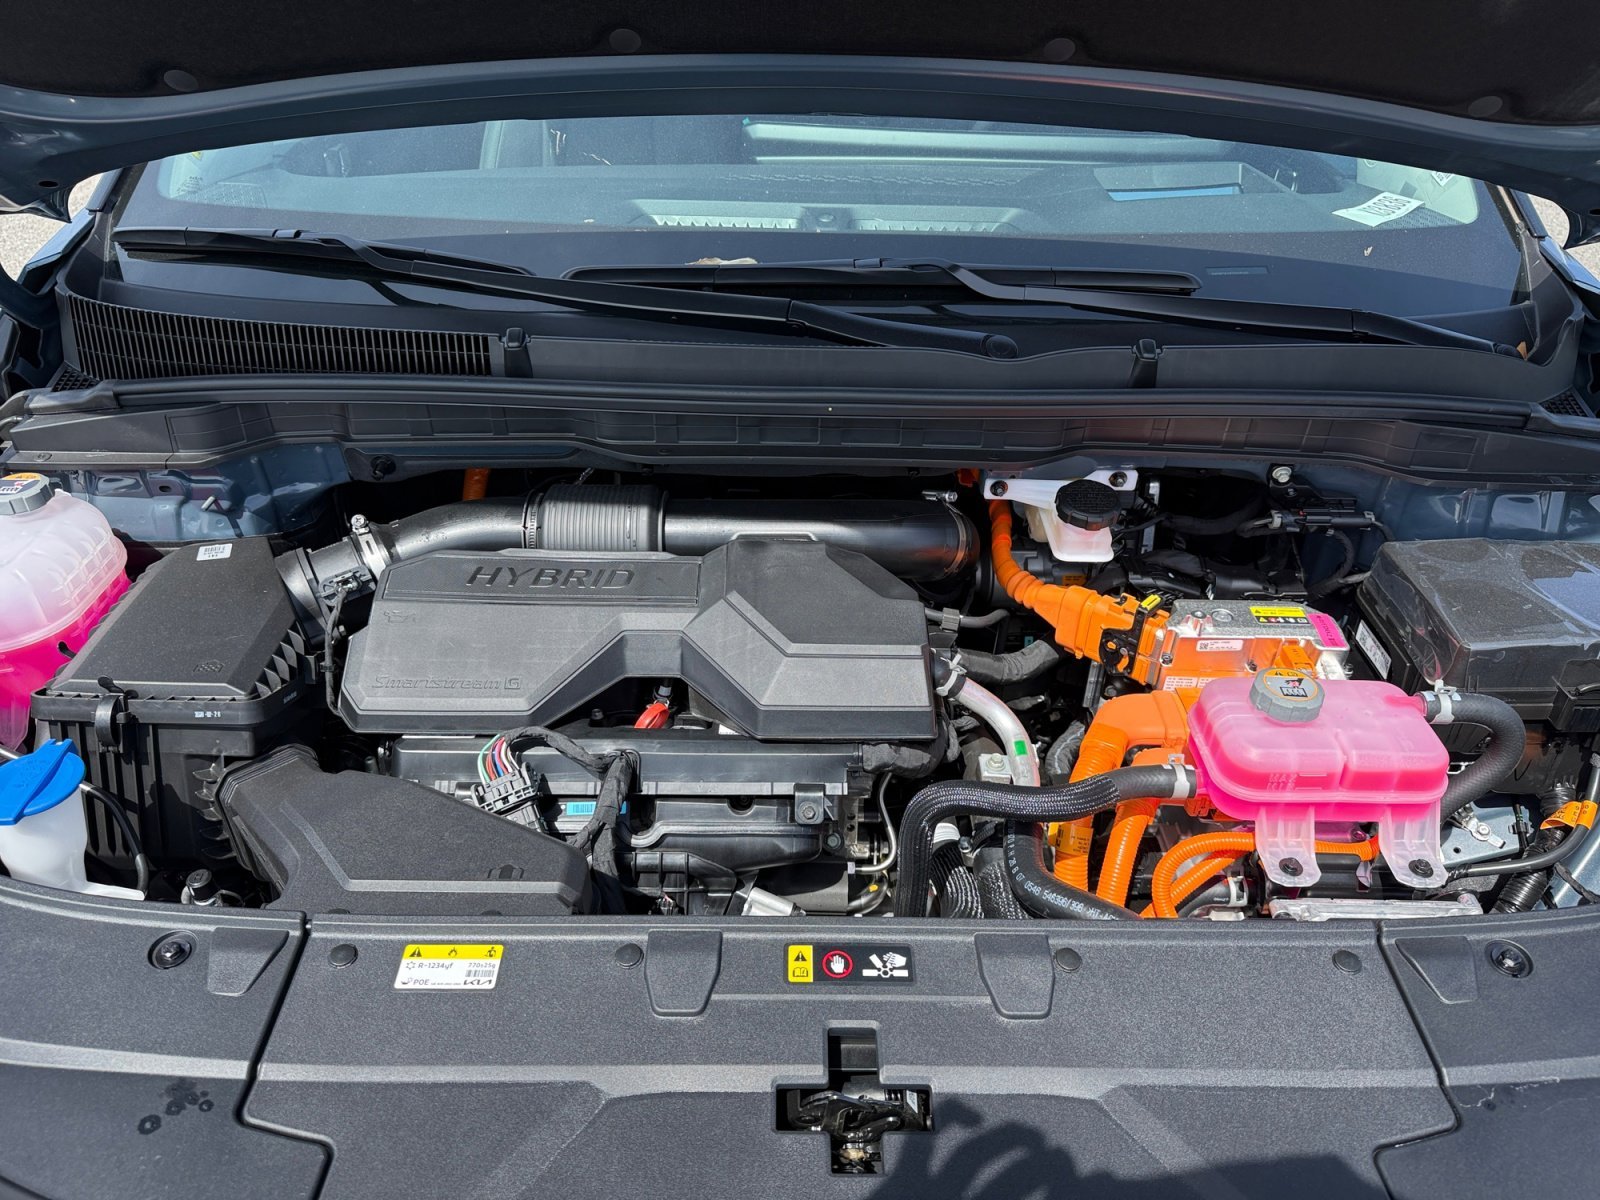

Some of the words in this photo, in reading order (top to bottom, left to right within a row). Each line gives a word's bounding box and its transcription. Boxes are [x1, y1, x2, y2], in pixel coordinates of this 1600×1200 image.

[465, 565, 636, 589] HYBRID
[371, 675, 500, 690] Smartstream
[1024, 881, 1041, 896] 0546
[417, 962, 453, 970] R-1234yf
